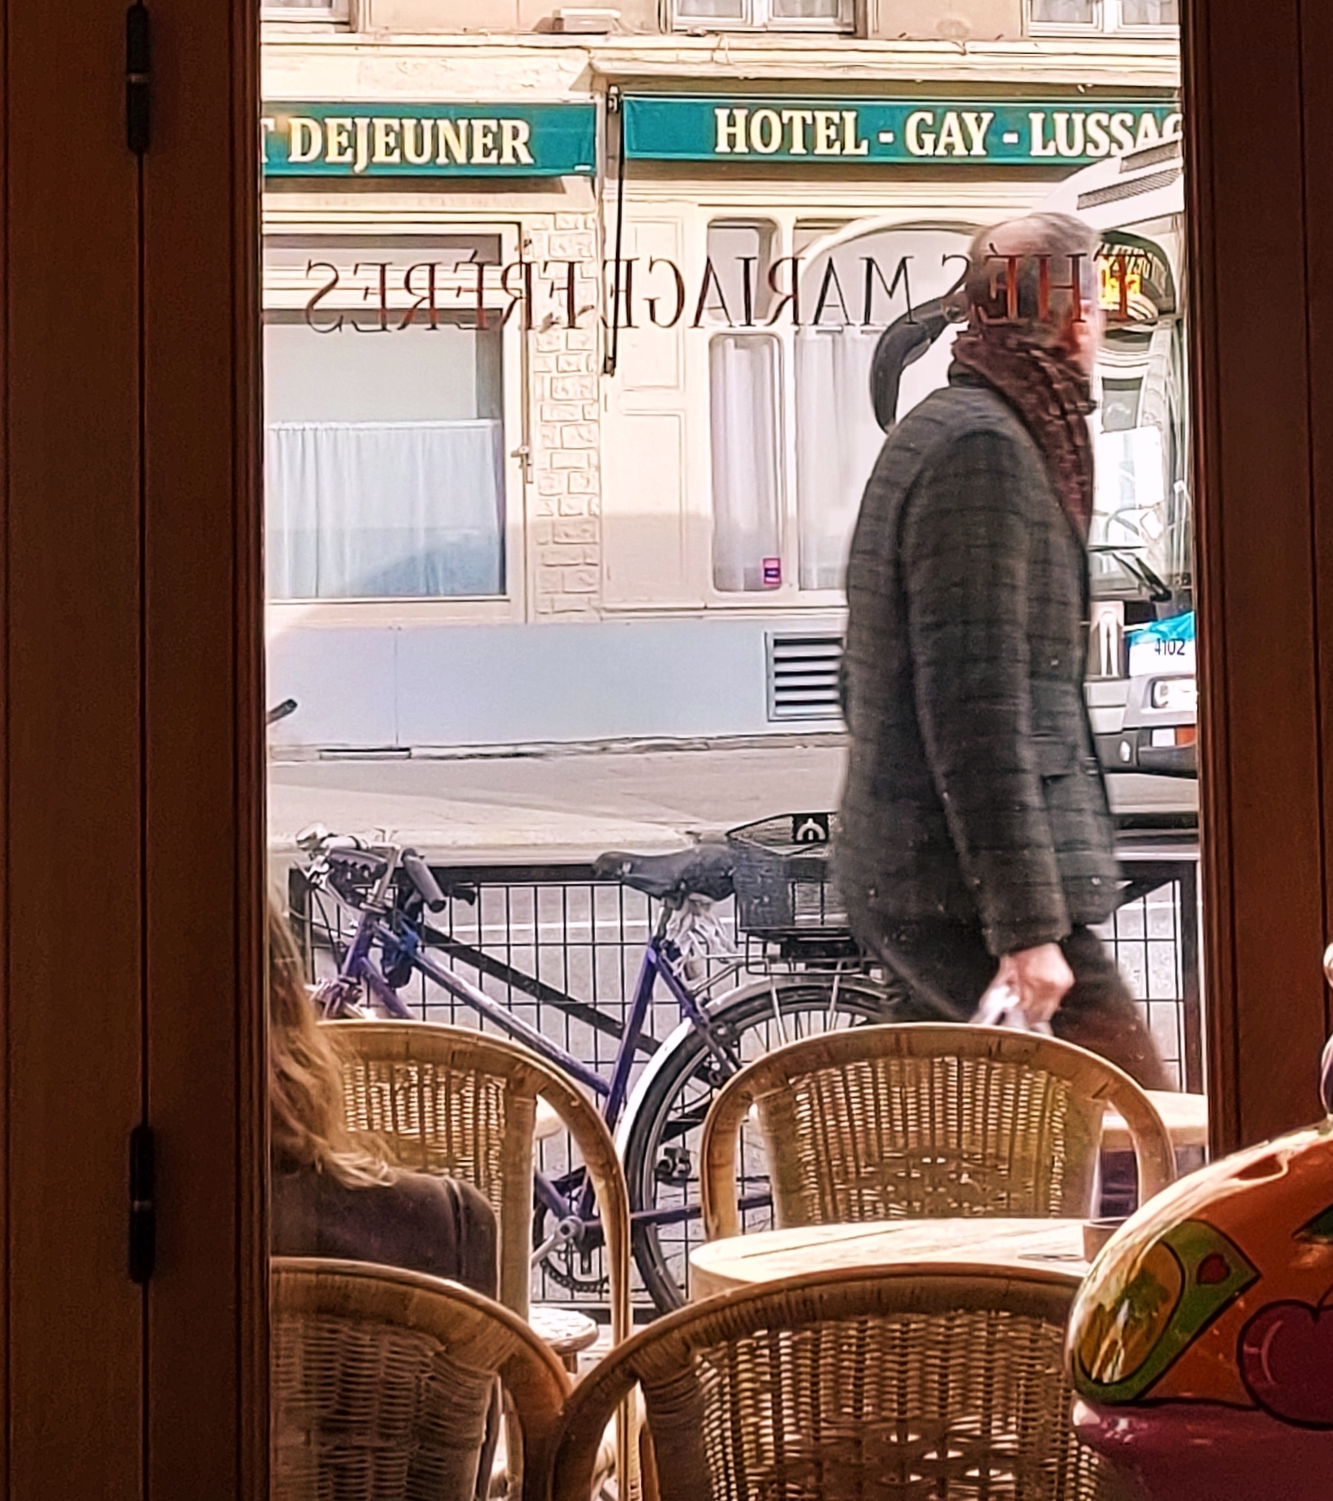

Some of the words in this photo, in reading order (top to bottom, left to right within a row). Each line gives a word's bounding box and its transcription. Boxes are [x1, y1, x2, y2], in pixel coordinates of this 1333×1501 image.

[287, 117, 535, 174] DEJEUNER
[713, 108, 869, 155] HOTEL
[903, 110, 994, 157] GAY
[1152, 638, 1186, 658] 4102
